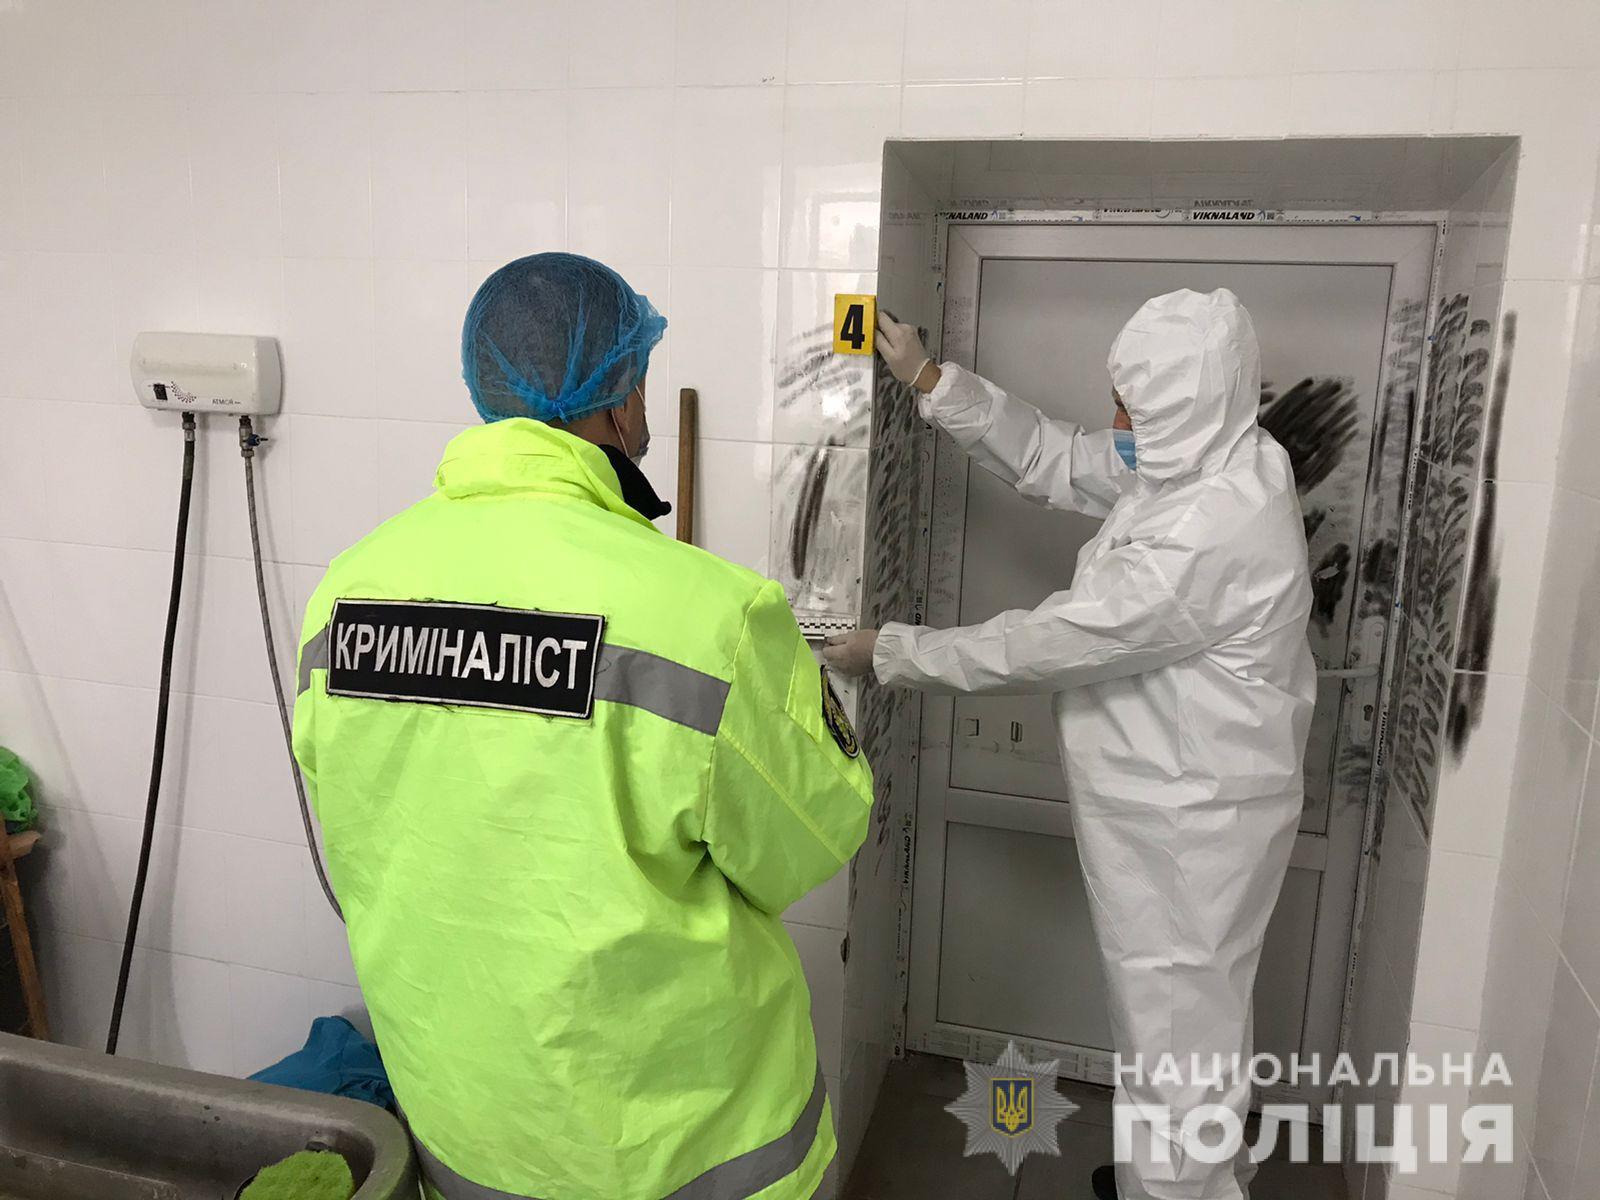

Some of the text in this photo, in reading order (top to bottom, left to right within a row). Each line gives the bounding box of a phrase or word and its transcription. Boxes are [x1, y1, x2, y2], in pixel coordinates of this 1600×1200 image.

[1193, 211, 1255, 220] VIKNALAND
[840, 304, 865, 350] 4
[335, 622, 588, 690] КРИМІНАЛІСТ
